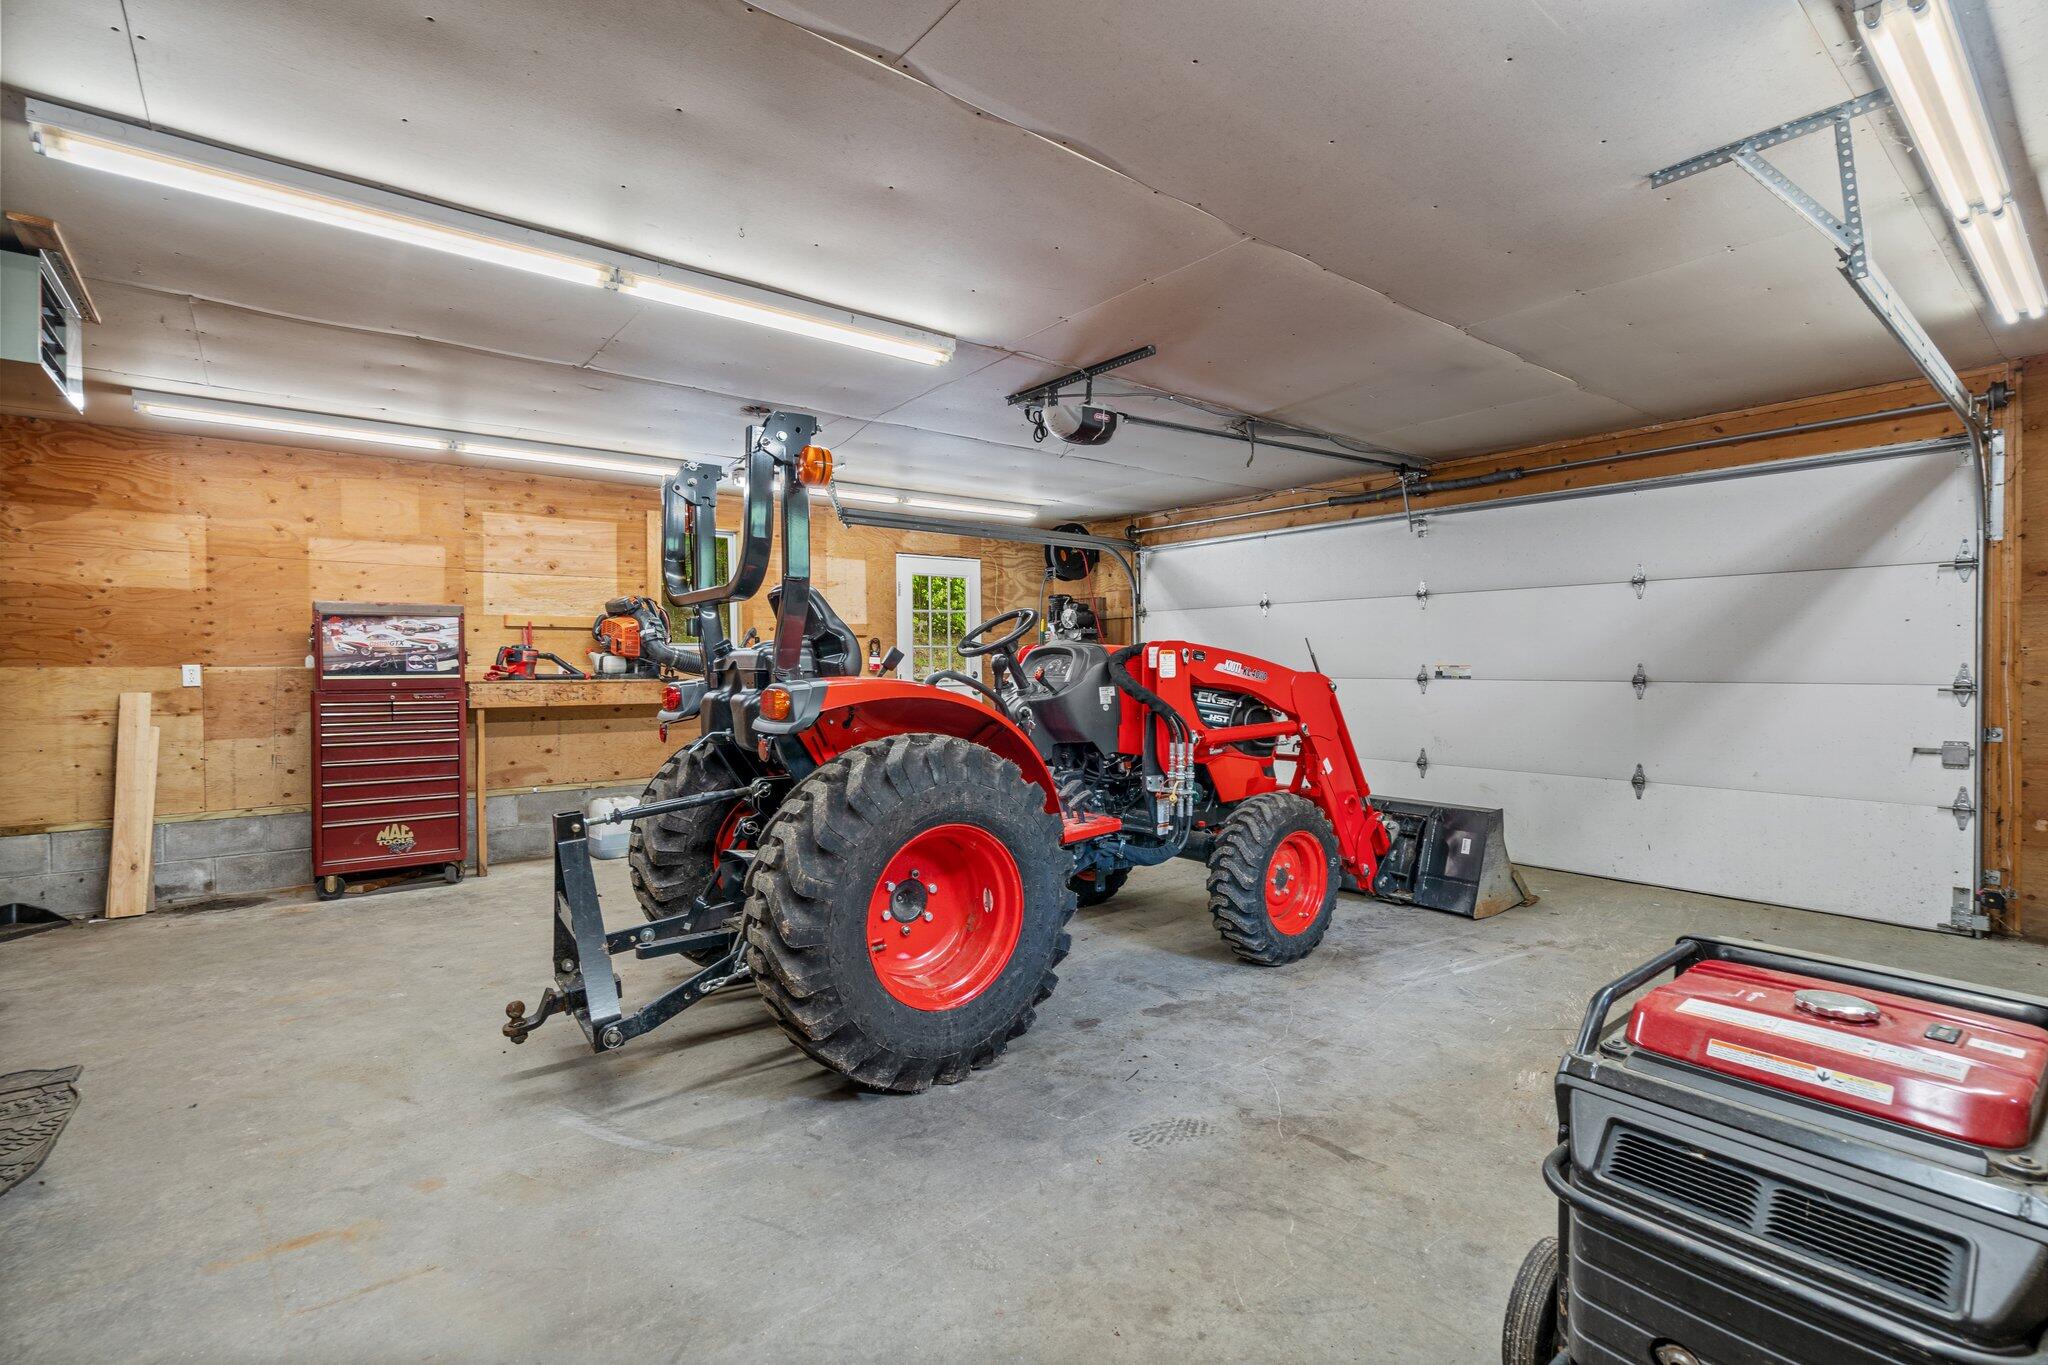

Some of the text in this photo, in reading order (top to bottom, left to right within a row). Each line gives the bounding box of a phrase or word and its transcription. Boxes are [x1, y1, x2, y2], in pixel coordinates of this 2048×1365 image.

[329, 659, 381, 671] 1997
[1208, 714, 1230, 723] HST
[376, 823, 414, 841] MAC
